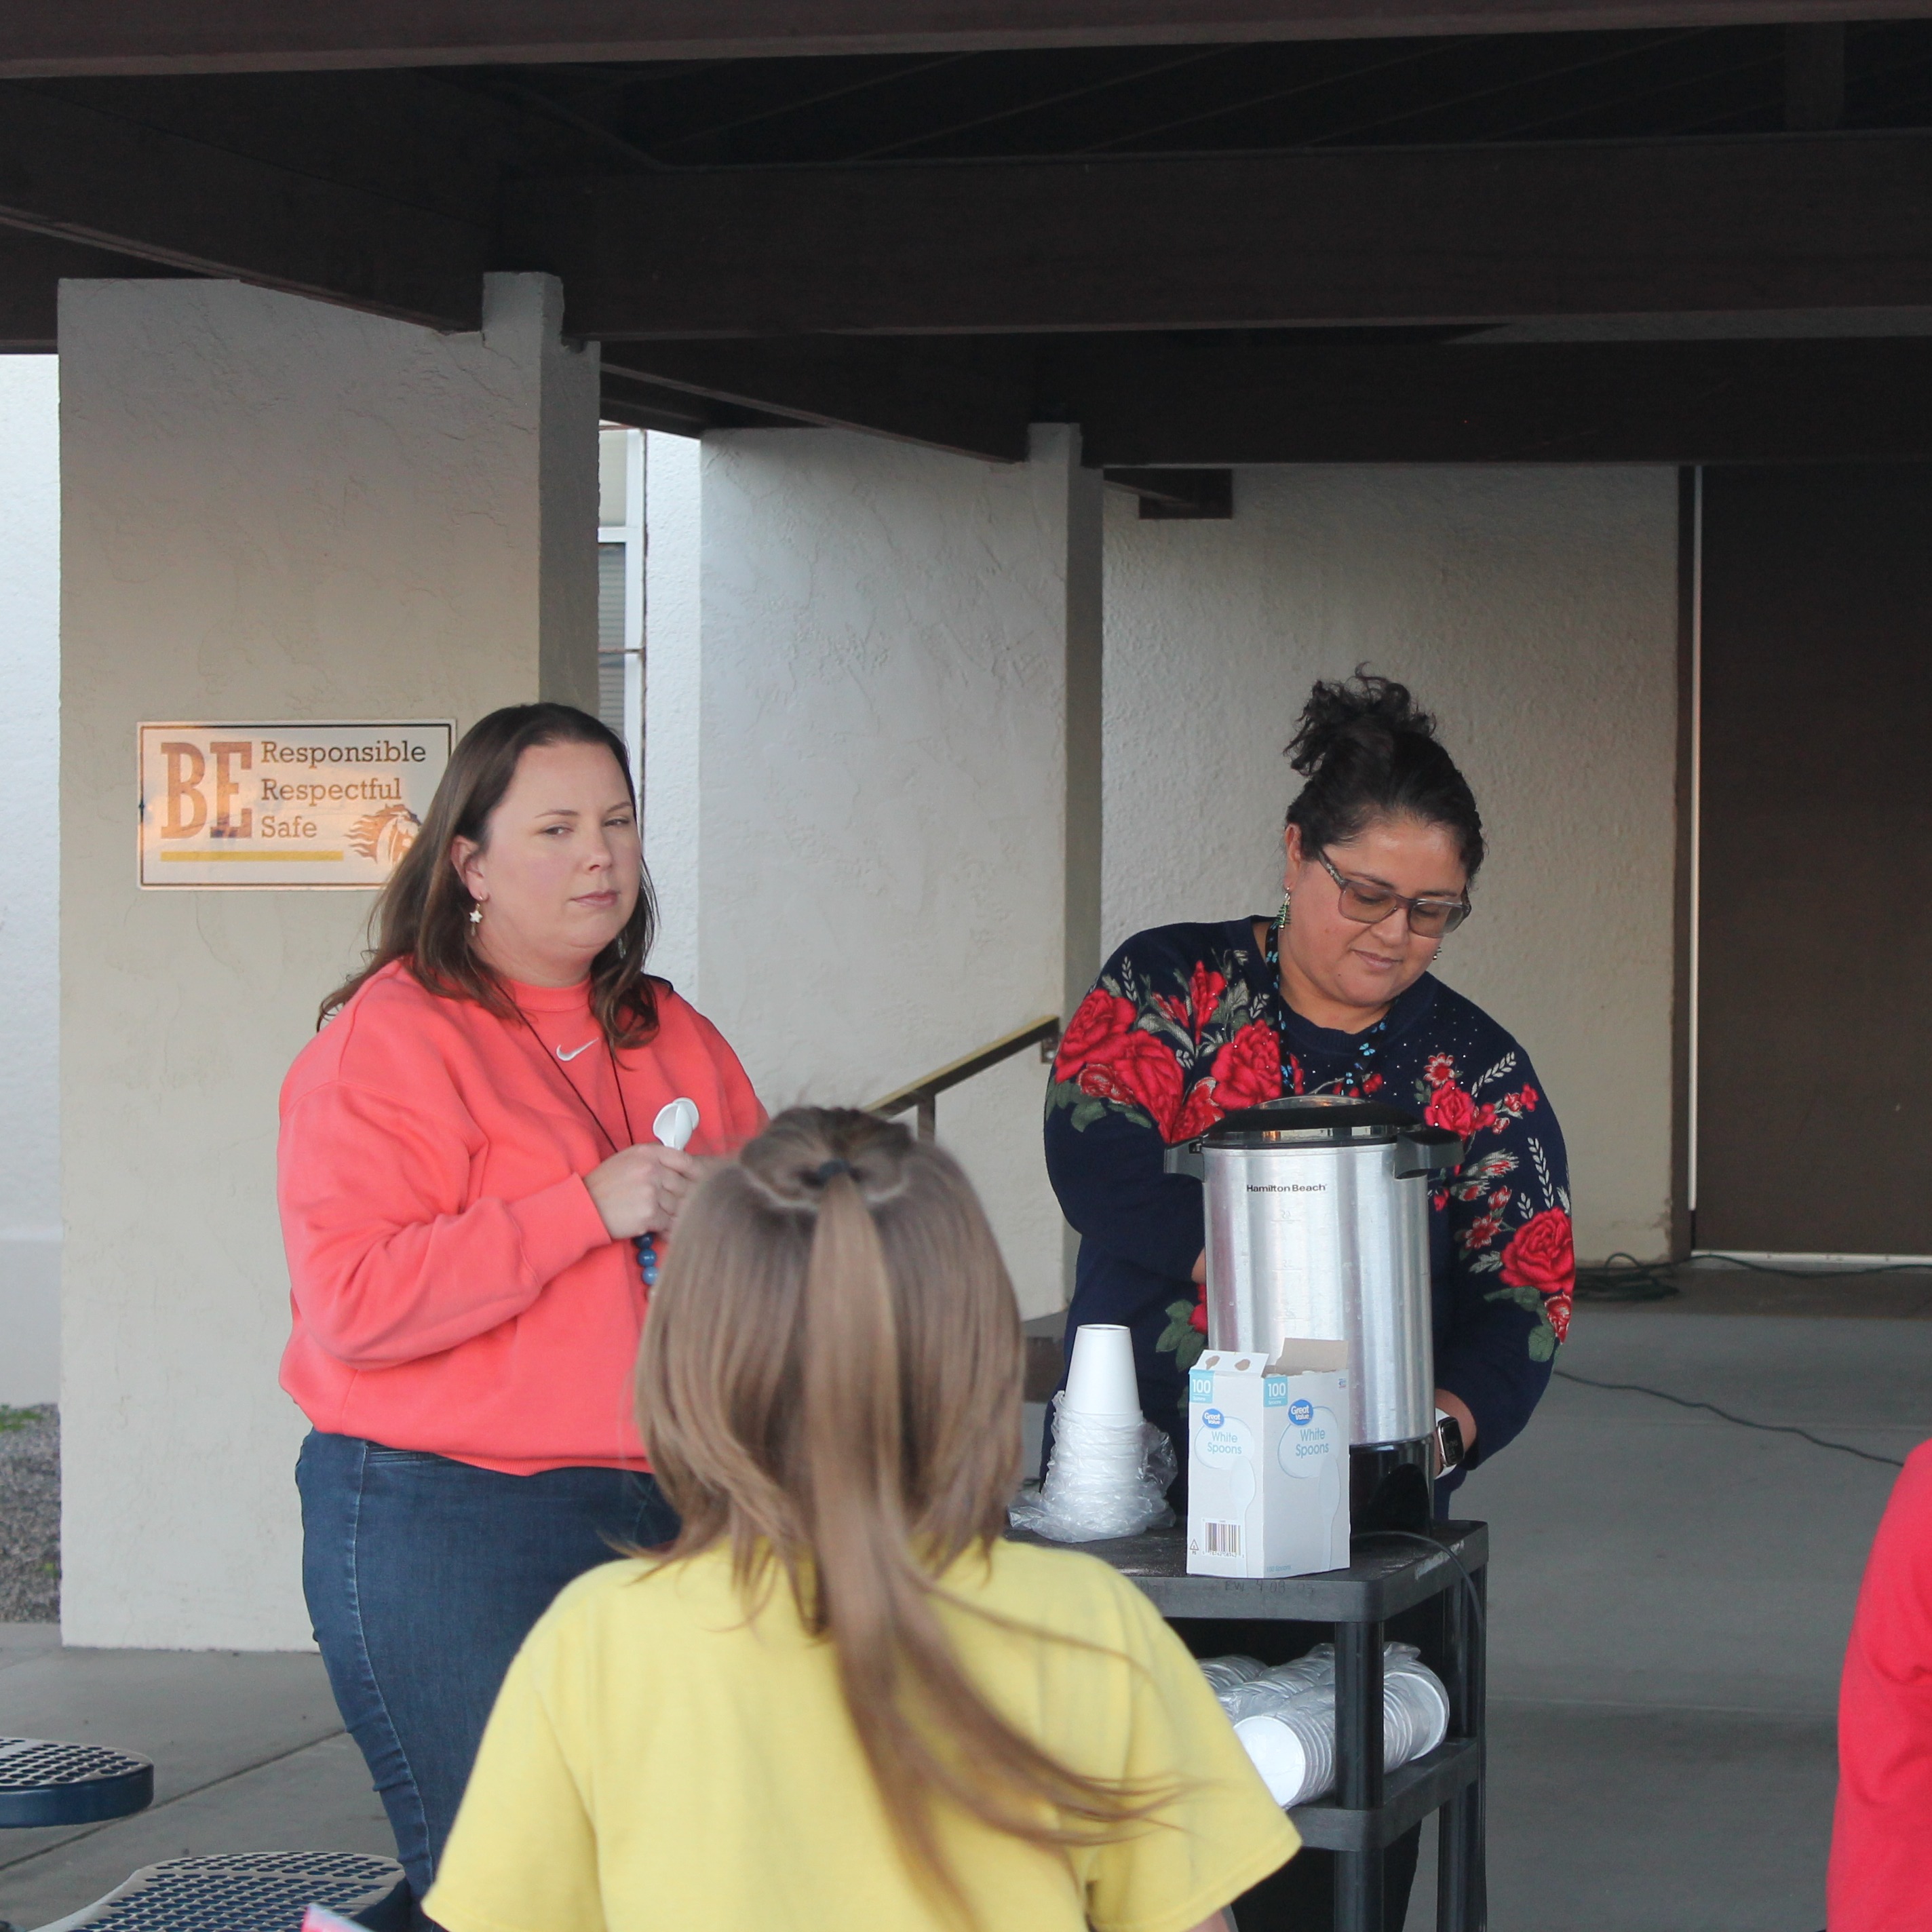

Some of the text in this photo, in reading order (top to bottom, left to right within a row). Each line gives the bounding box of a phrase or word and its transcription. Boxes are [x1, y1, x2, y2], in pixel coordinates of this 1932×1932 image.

[260, 740, 426, 769] Responsible
[160, 741, 252, 839] BE
[260, 777, 402, 807] Respectful
[260, 815, 317, 839] Safe
[1246, 1184, 1326, 1193] Hamilton Beach
[1193, 1378, 1211, 1394] 100
[1267, 1383, 1286, 1397] 100
[1204, 1412, 1221, 1421] Great
[1291, 1404, 1310, 1416] Great
[1211, 1431, 1238, 1443] White
[1300, 1427, 1326, 1442] White
[1207, 1442, 1242, 1455] Spoons
[1295, 1443, 1330, 1459] Spoons
